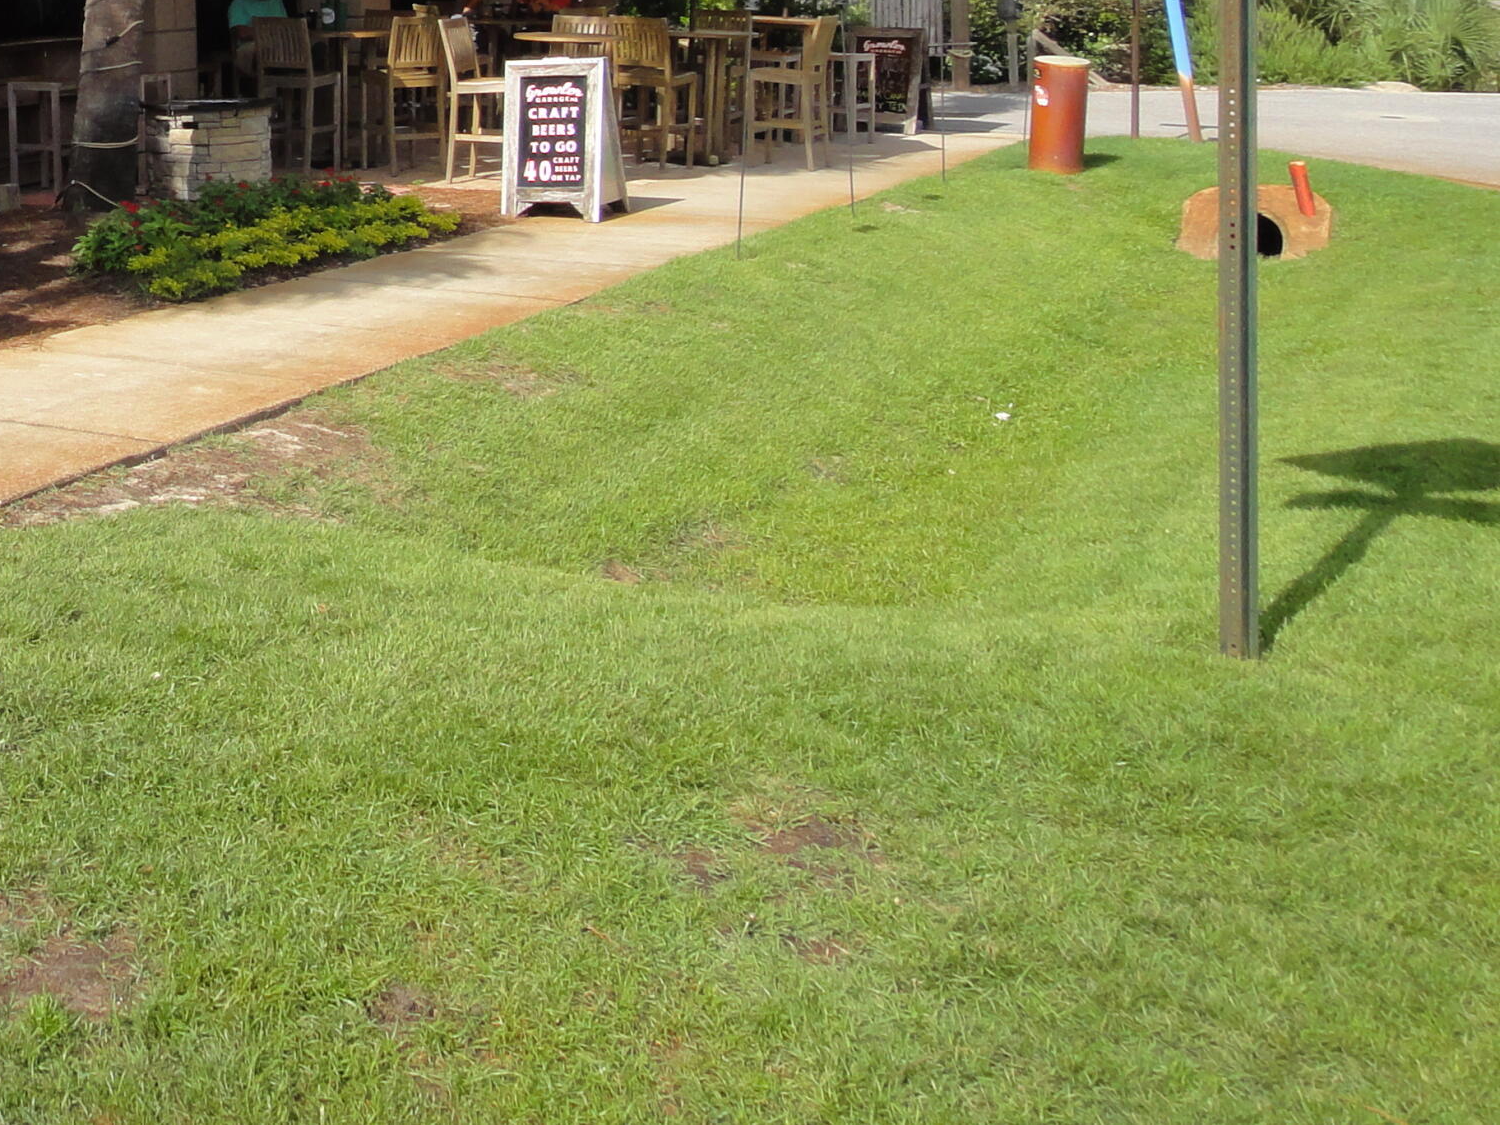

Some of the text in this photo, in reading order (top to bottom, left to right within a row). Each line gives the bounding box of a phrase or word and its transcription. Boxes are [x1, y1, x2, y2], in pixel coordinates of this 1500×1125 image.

[528, 107, 580, 120] CRAFT
[532, 124, 576, 136] BEERS
[530, 141, 578, 154] TO GO
[523, 159, 552, 182] 40
[554, 165, 578, 173] BEERS
